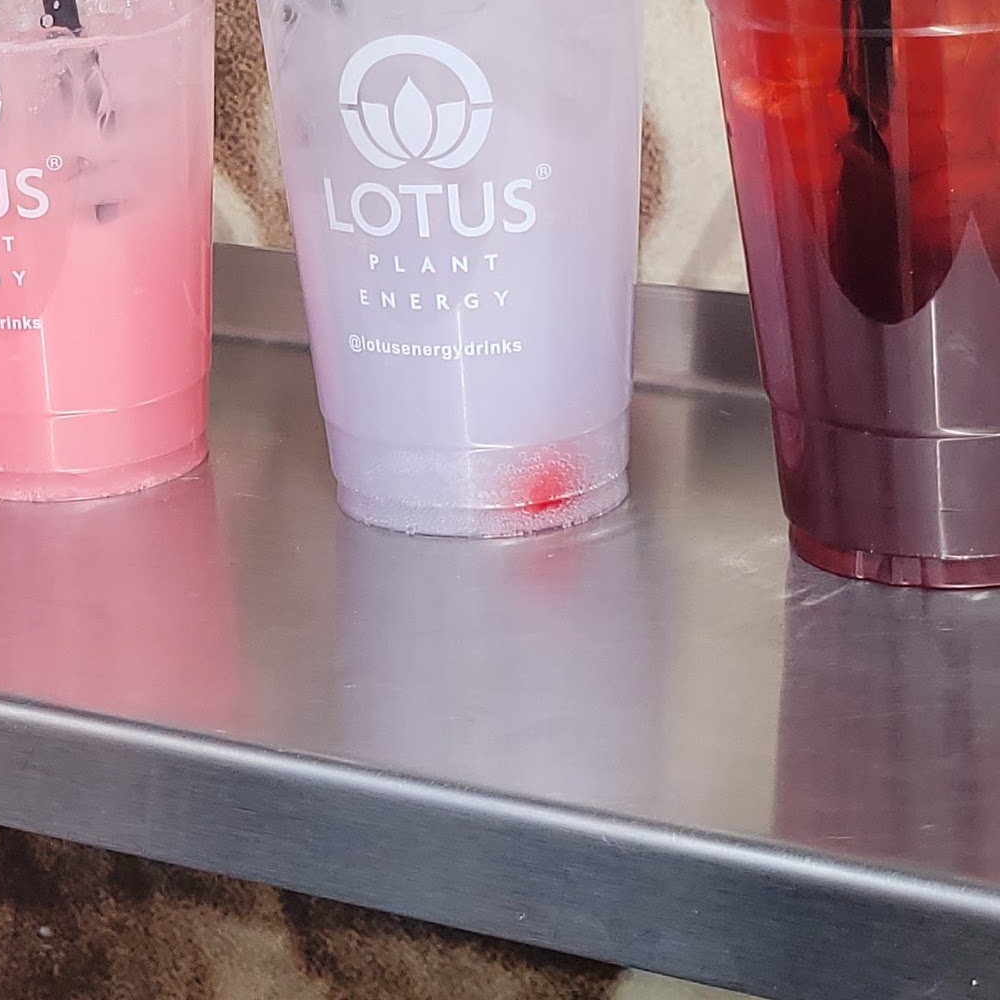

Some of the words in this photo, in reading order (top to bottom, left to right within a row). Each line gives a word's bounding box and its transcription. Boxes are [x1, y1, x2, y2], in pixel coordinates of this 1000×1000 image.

[368, 253, 499, 274] PLANT
[359, 288, 510, 311] ENERGY
[348, 334, 523, 360] @lotusenergydrinks
